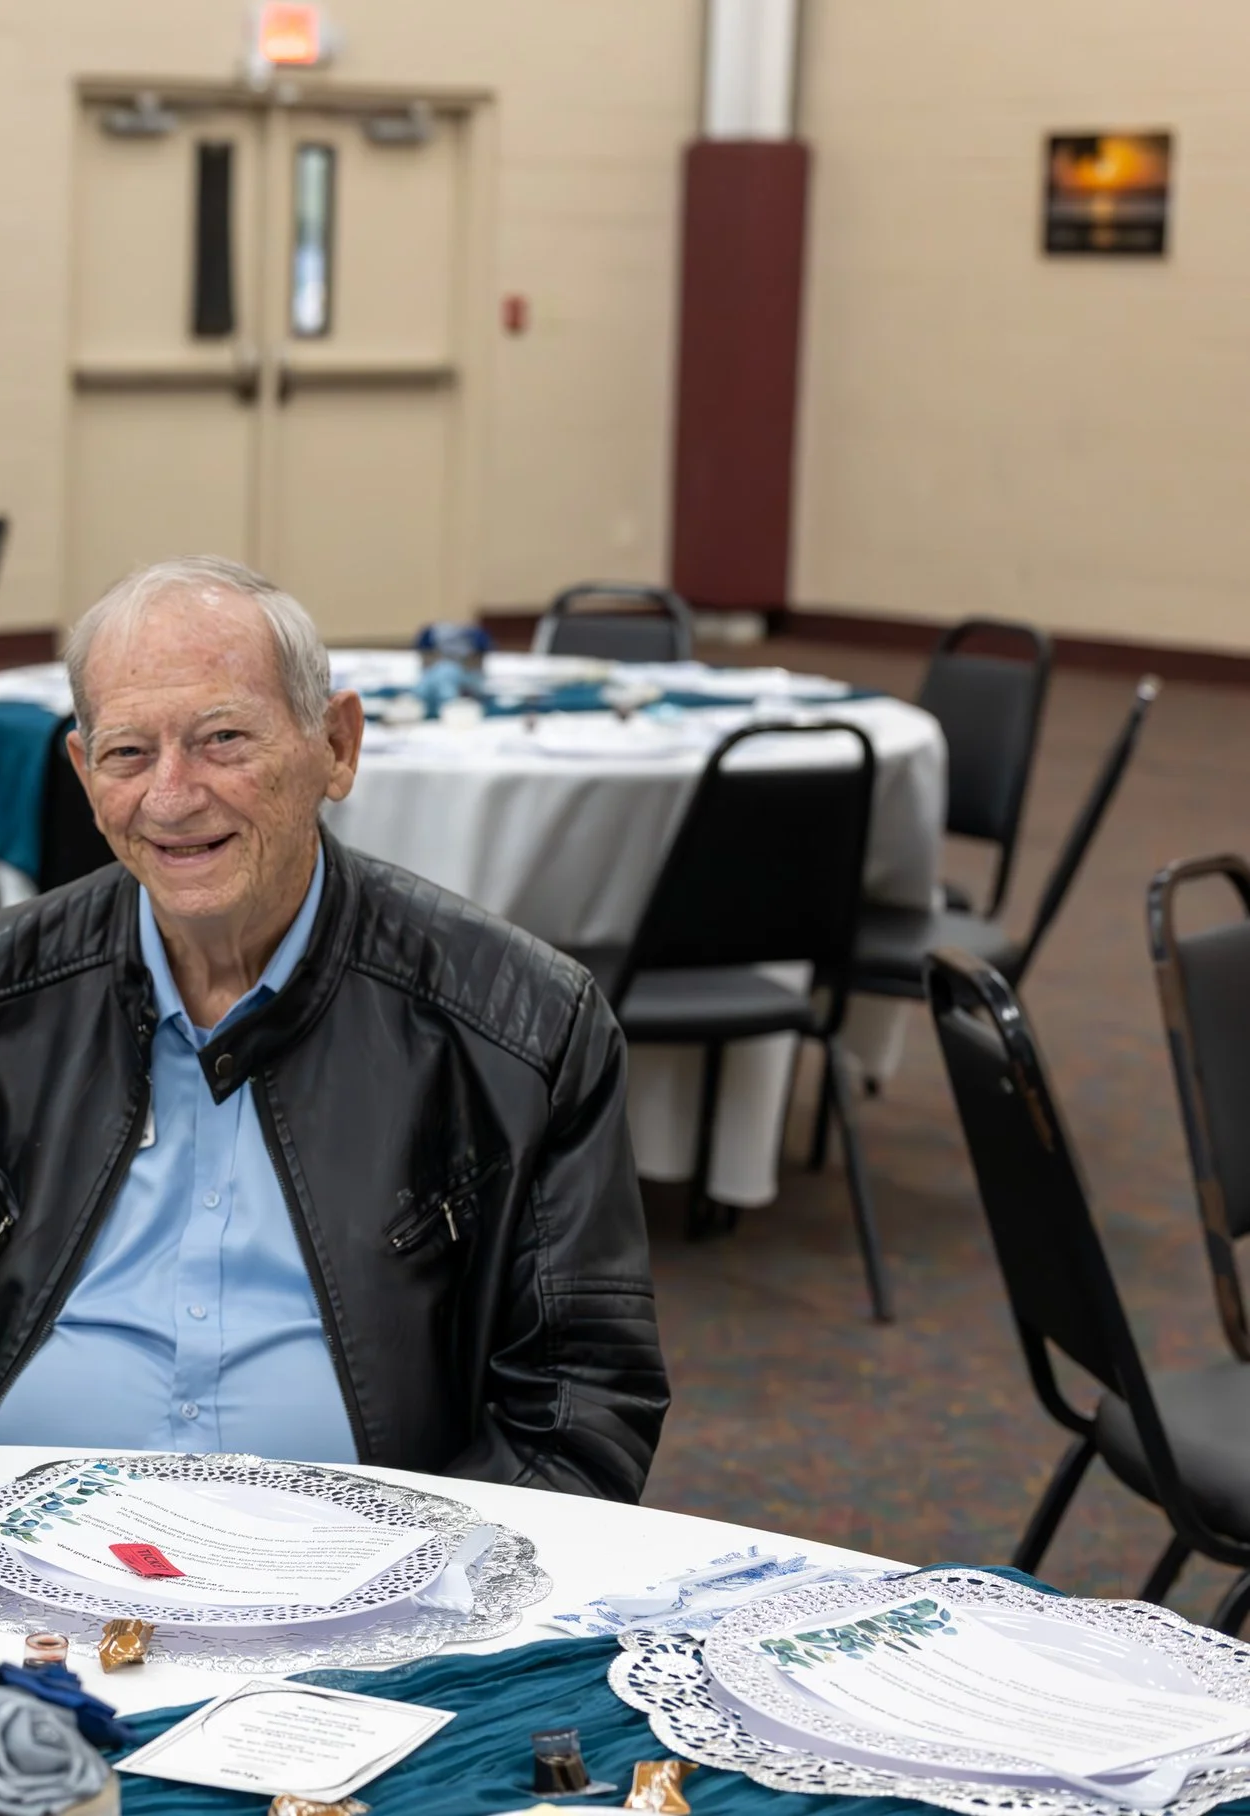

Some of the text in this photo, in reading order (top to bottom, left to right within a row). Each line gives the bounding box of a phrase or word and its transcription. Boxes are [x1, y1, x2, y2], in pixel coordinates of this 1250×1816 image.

[74, 1551, 90, 1559] shall
[137, 1549, 170, 1571] TICKET
[103, 1563, 127, 1572] season
